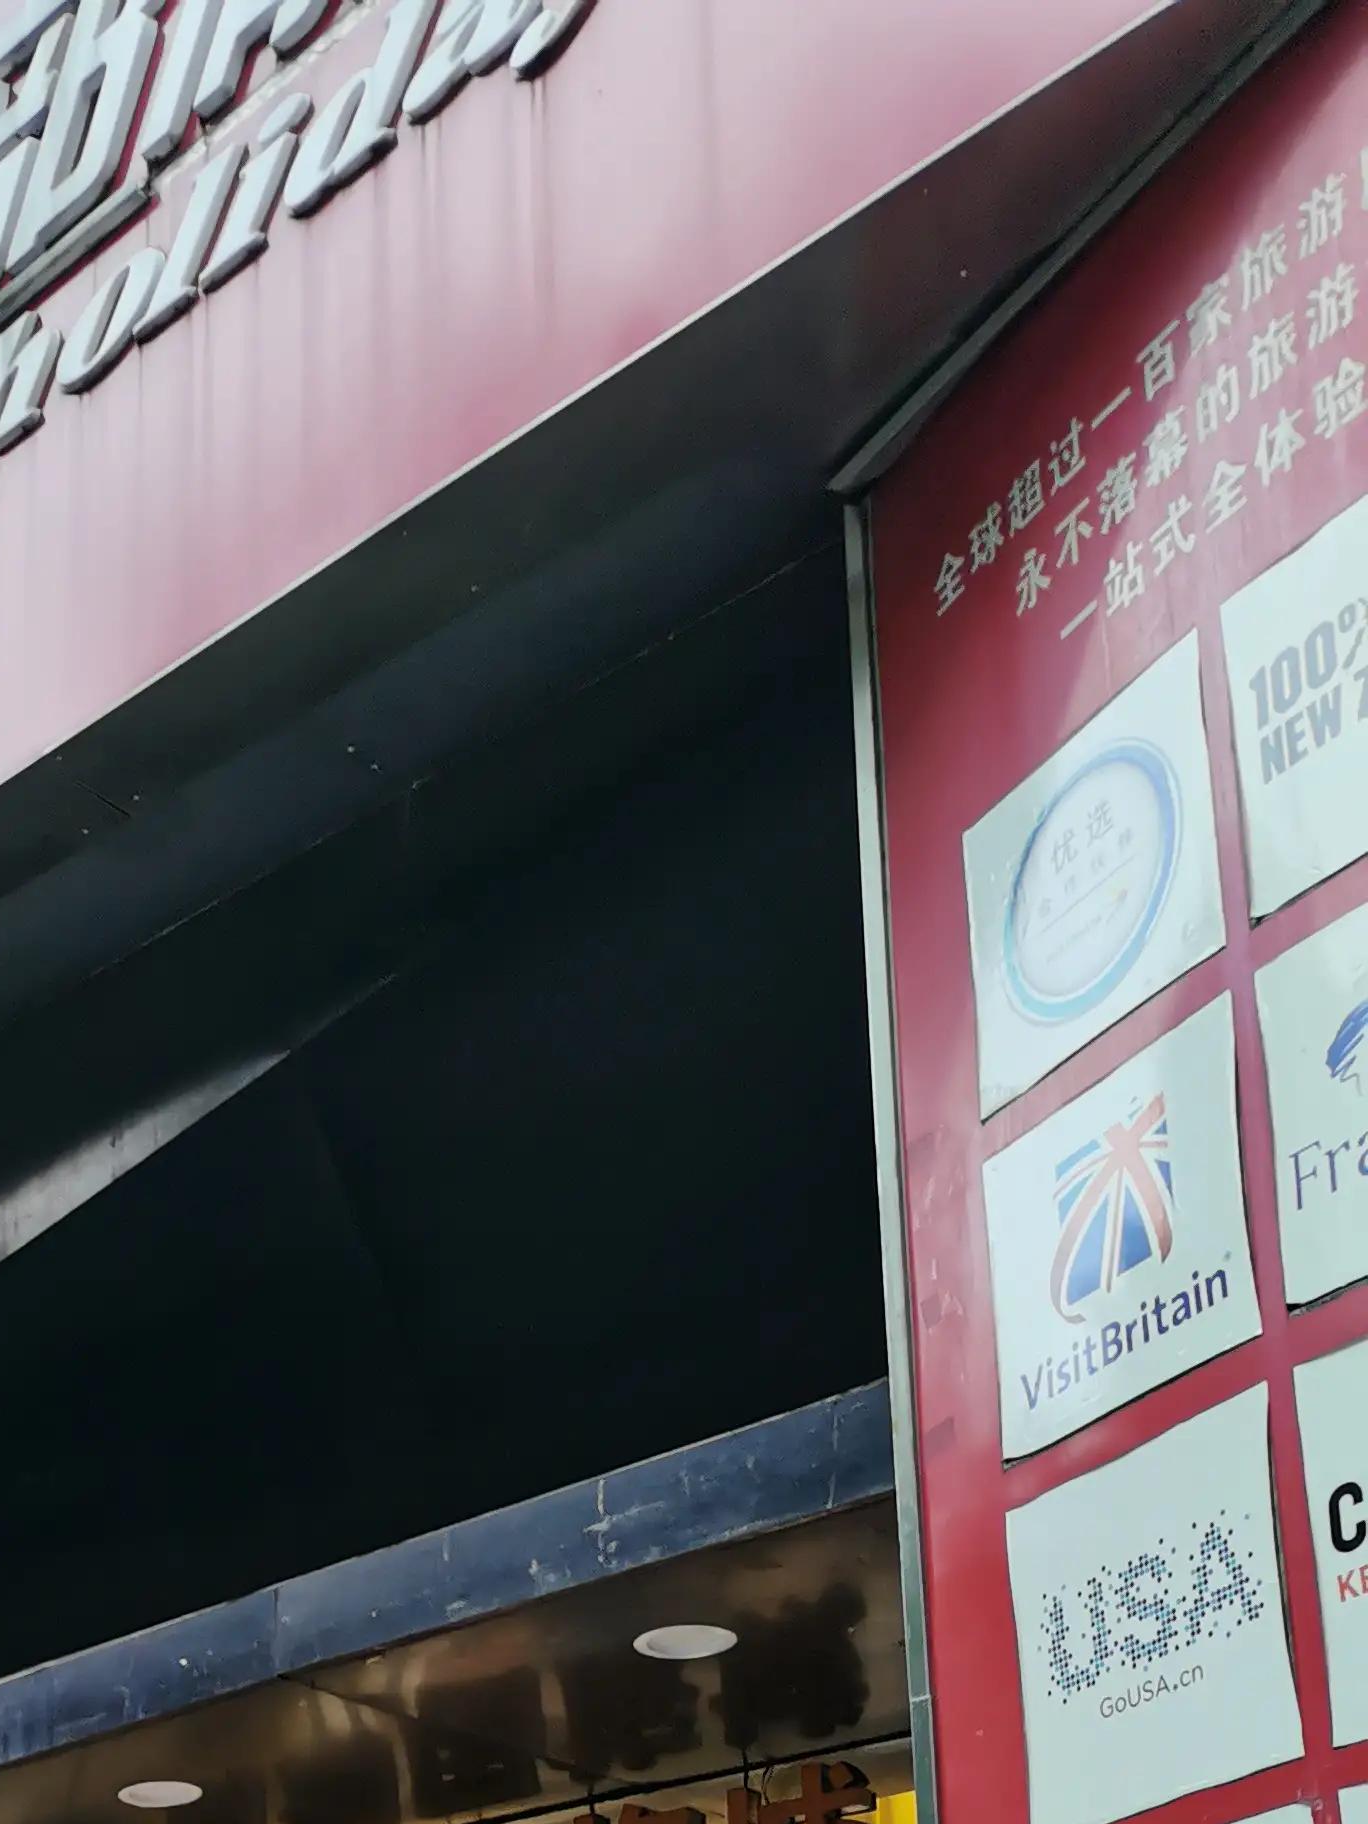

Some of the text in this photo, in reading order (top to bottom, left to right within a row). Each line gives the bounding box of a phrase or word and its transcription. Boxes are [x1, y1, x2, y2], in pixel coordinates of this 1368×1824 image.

[935, 150, 1368, 617] 全球超过一百家旅游
[1259, 683, 1344, 786] NEW
[1049, 801, 1117, 876] 优选
[1021, 1267, 1230, 1411] VisitBritain
[1042, 1515, 1264, 1702] USA
[1098, 1661, 1206, 1720] GoUSA.cn
